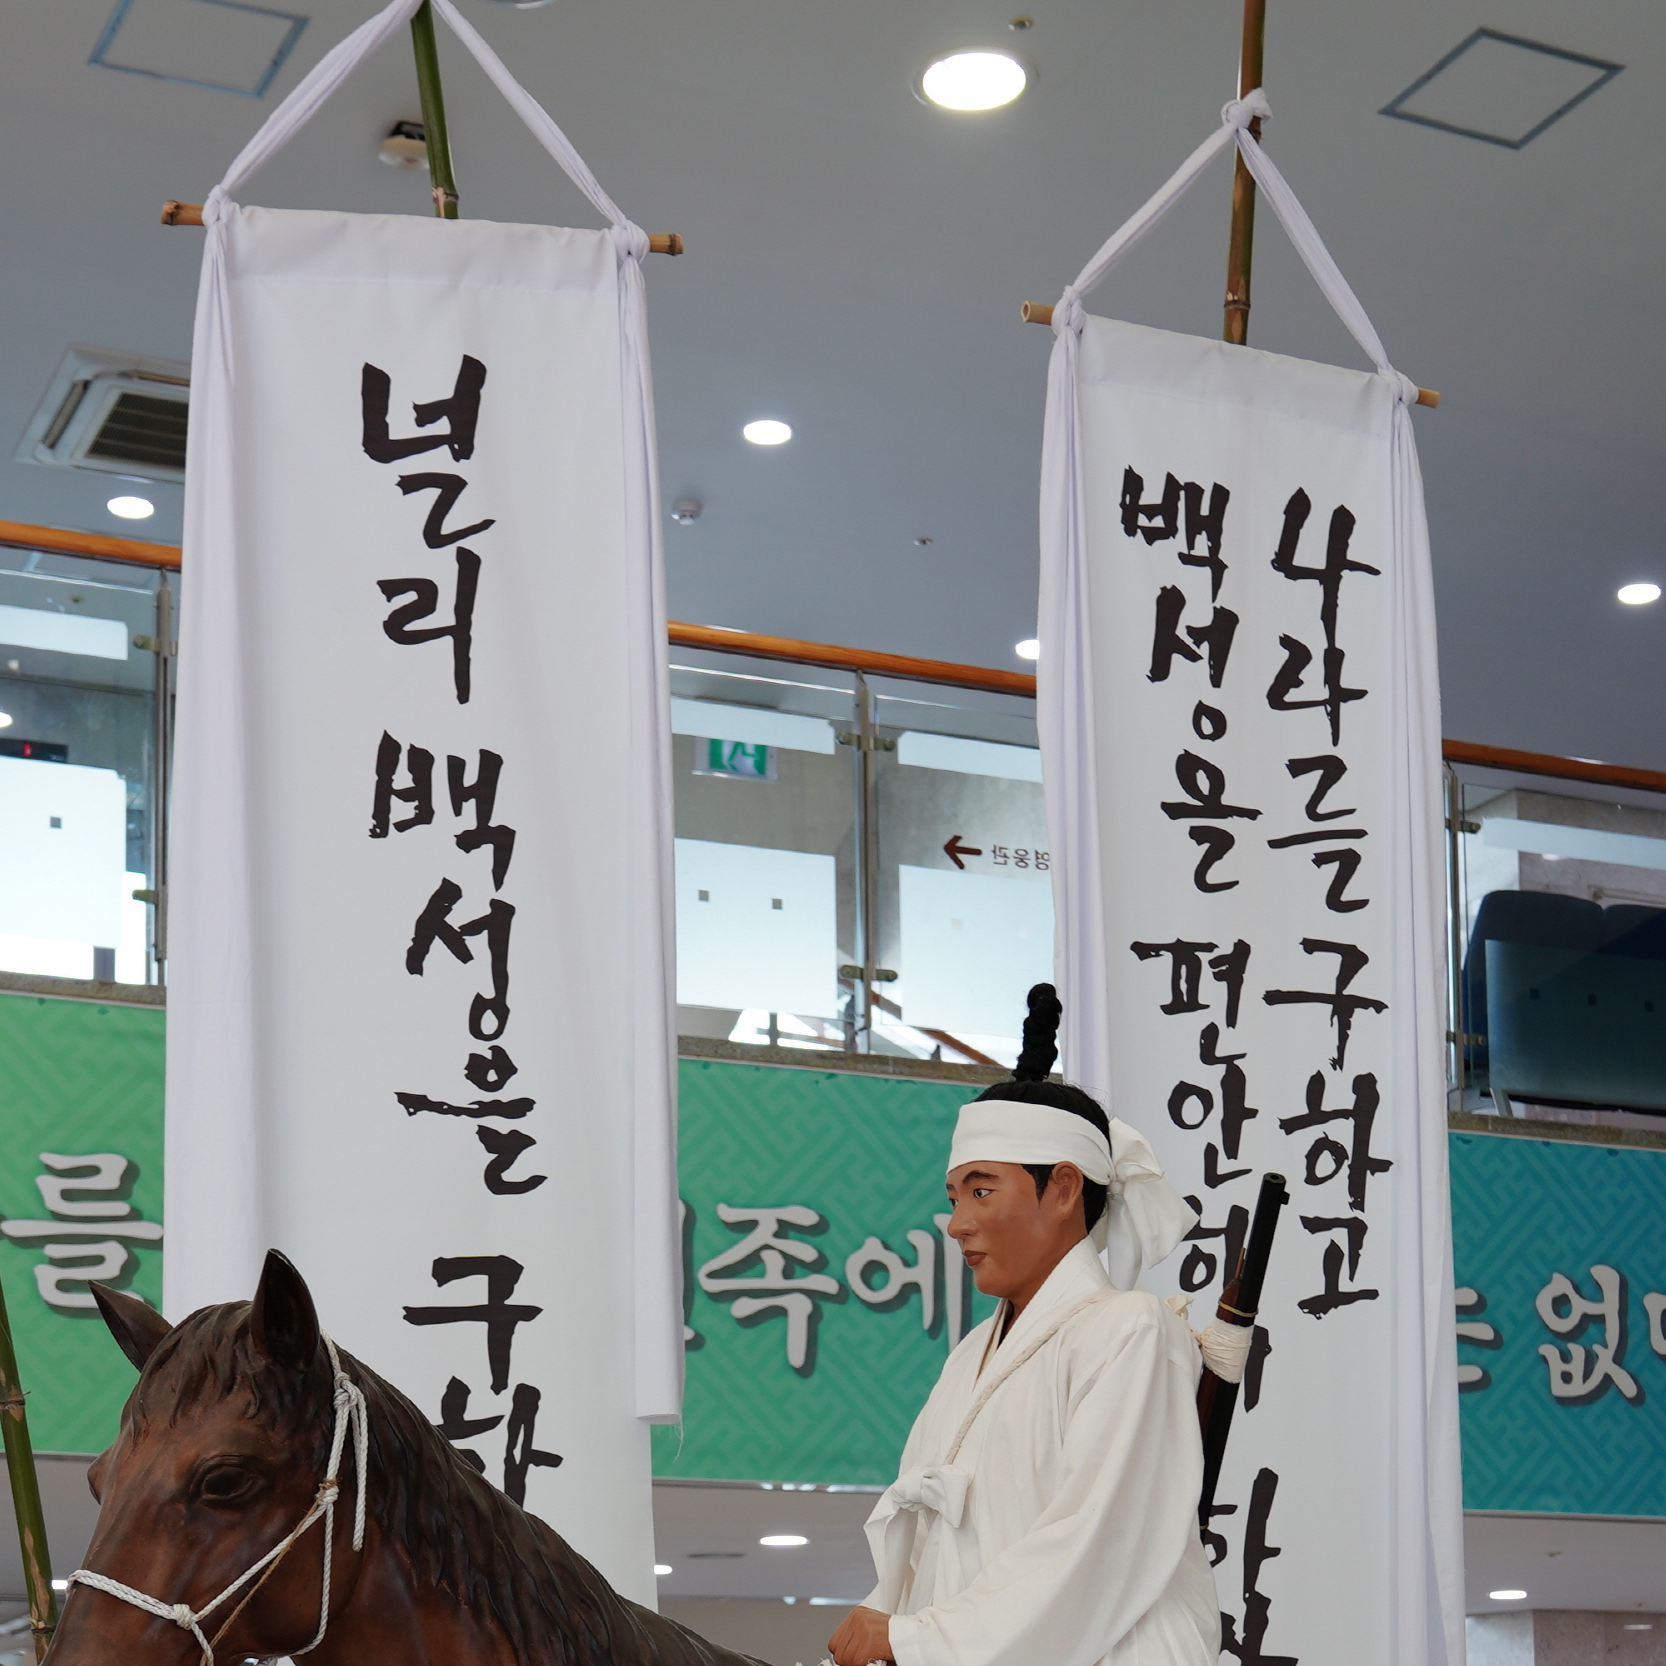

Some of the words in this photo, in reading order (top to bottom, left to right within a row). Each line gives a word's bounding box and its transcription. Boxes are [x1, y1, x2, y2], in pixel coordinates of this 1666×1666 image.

[360, 353, 497, 705] 널리
[1118, 465, 1264, 894] 백성을
[1266, 486, 1381, 914] 나라를
[368, 729, 548, 1197] 백성을
[1130, 937, 1273, 1414] 편안하
[1262, 937, 1394, 1321] 구하고
